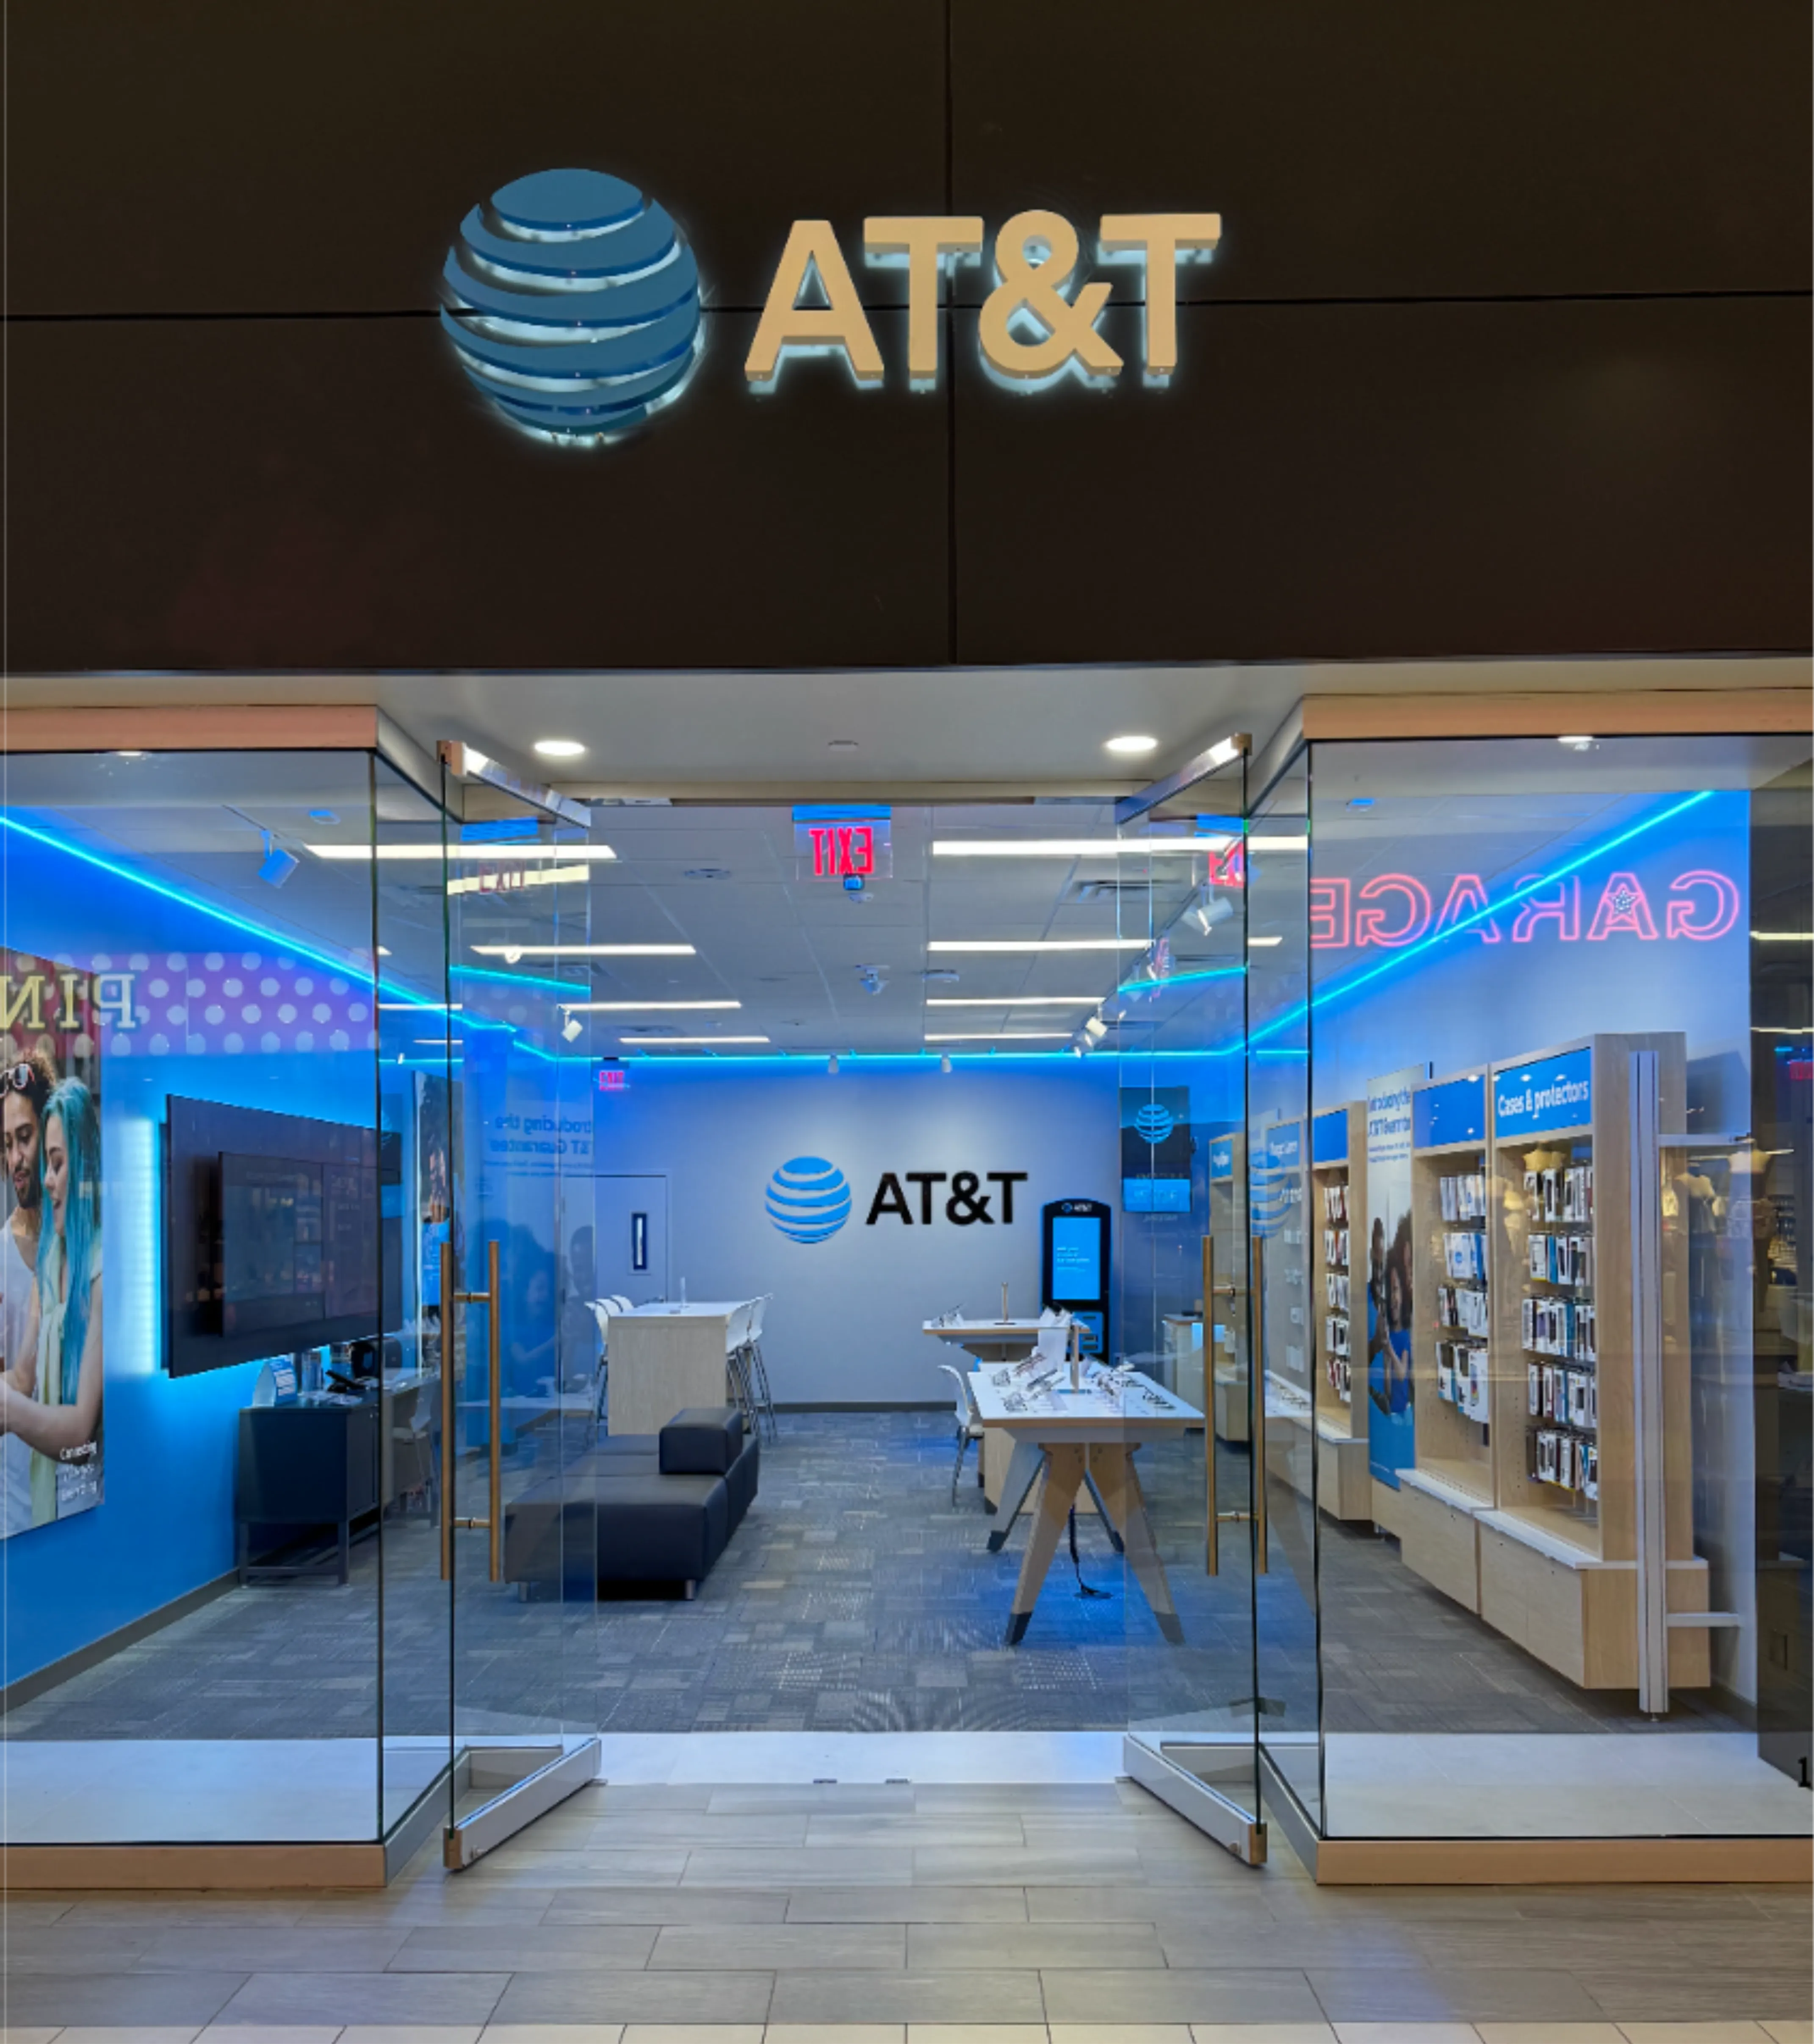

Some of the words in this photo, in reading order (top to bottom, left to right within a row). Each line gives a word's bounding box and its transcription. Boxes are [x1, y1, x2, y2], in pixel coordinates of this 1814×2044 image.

[744, 210, 1222, 383] AT&T
[1498, 1093, 1524, 1117] Cases
[1535, 1080, 1589, 1119] protectors
[866, 1171, 1028, 1226] AT&T
